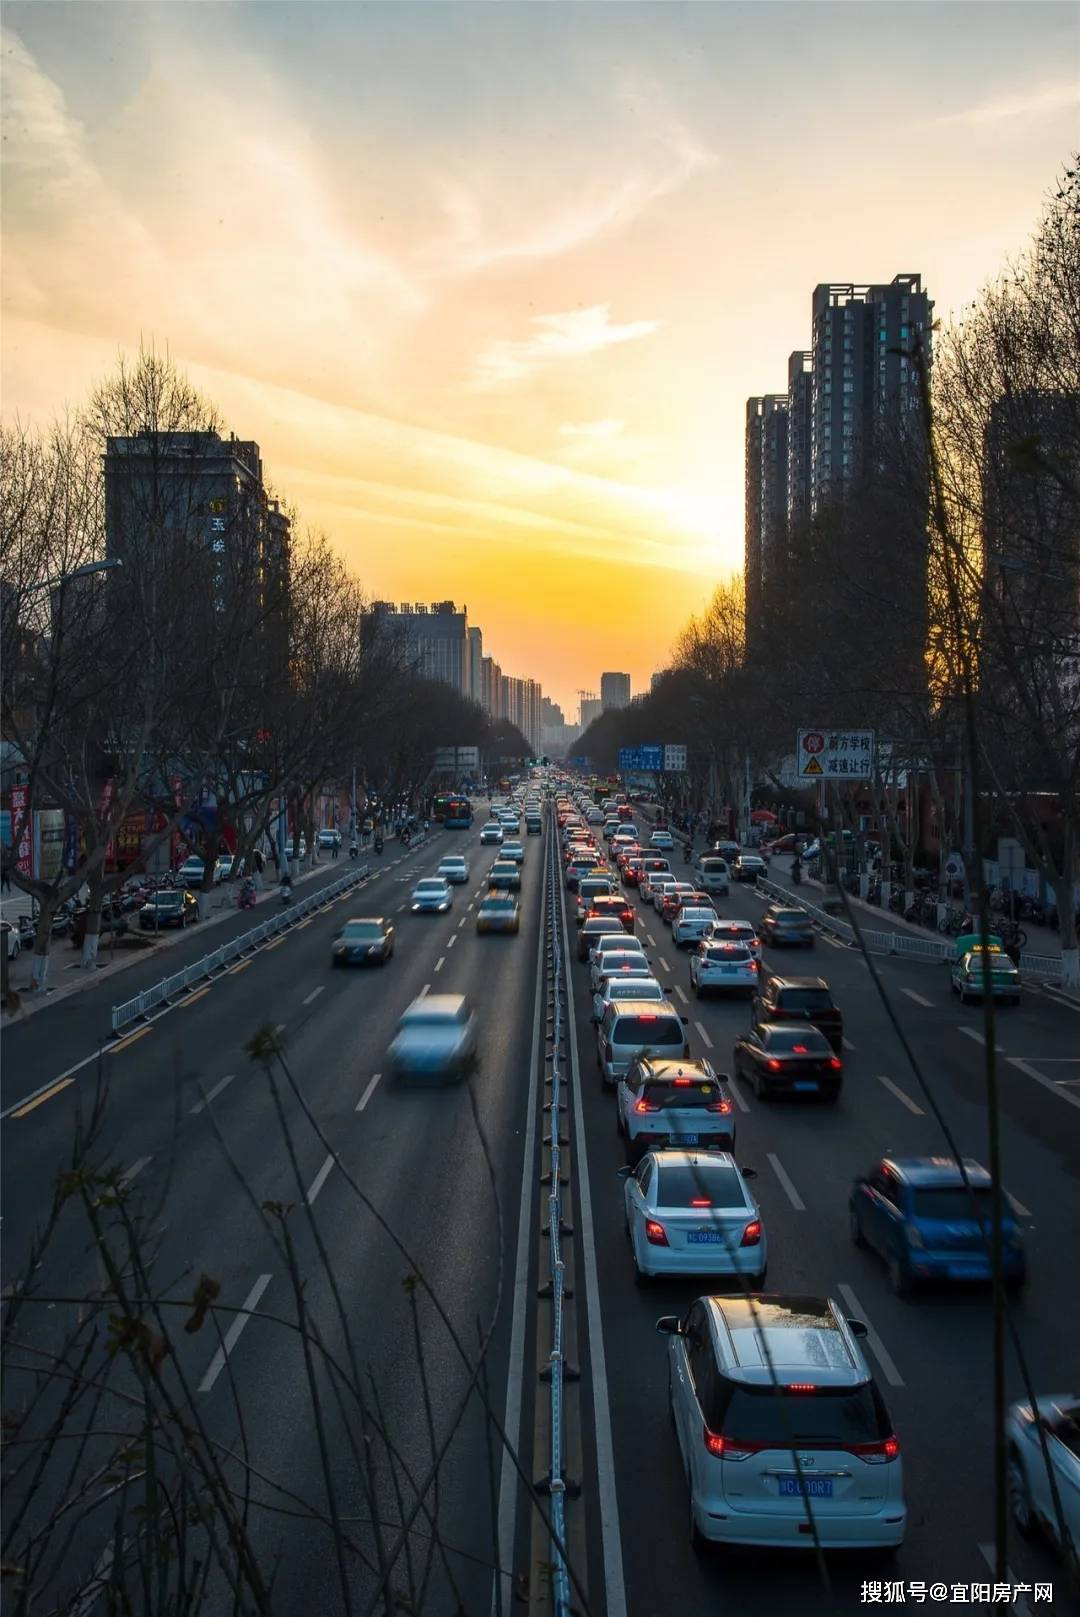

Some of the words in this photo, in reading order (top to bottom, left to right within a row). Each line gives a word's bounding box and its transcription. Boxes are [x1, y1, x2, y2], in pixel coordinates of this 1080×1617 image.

[829, 735, 870, 751] 前方学校
[828, 758, 870, 773] 减速让行
